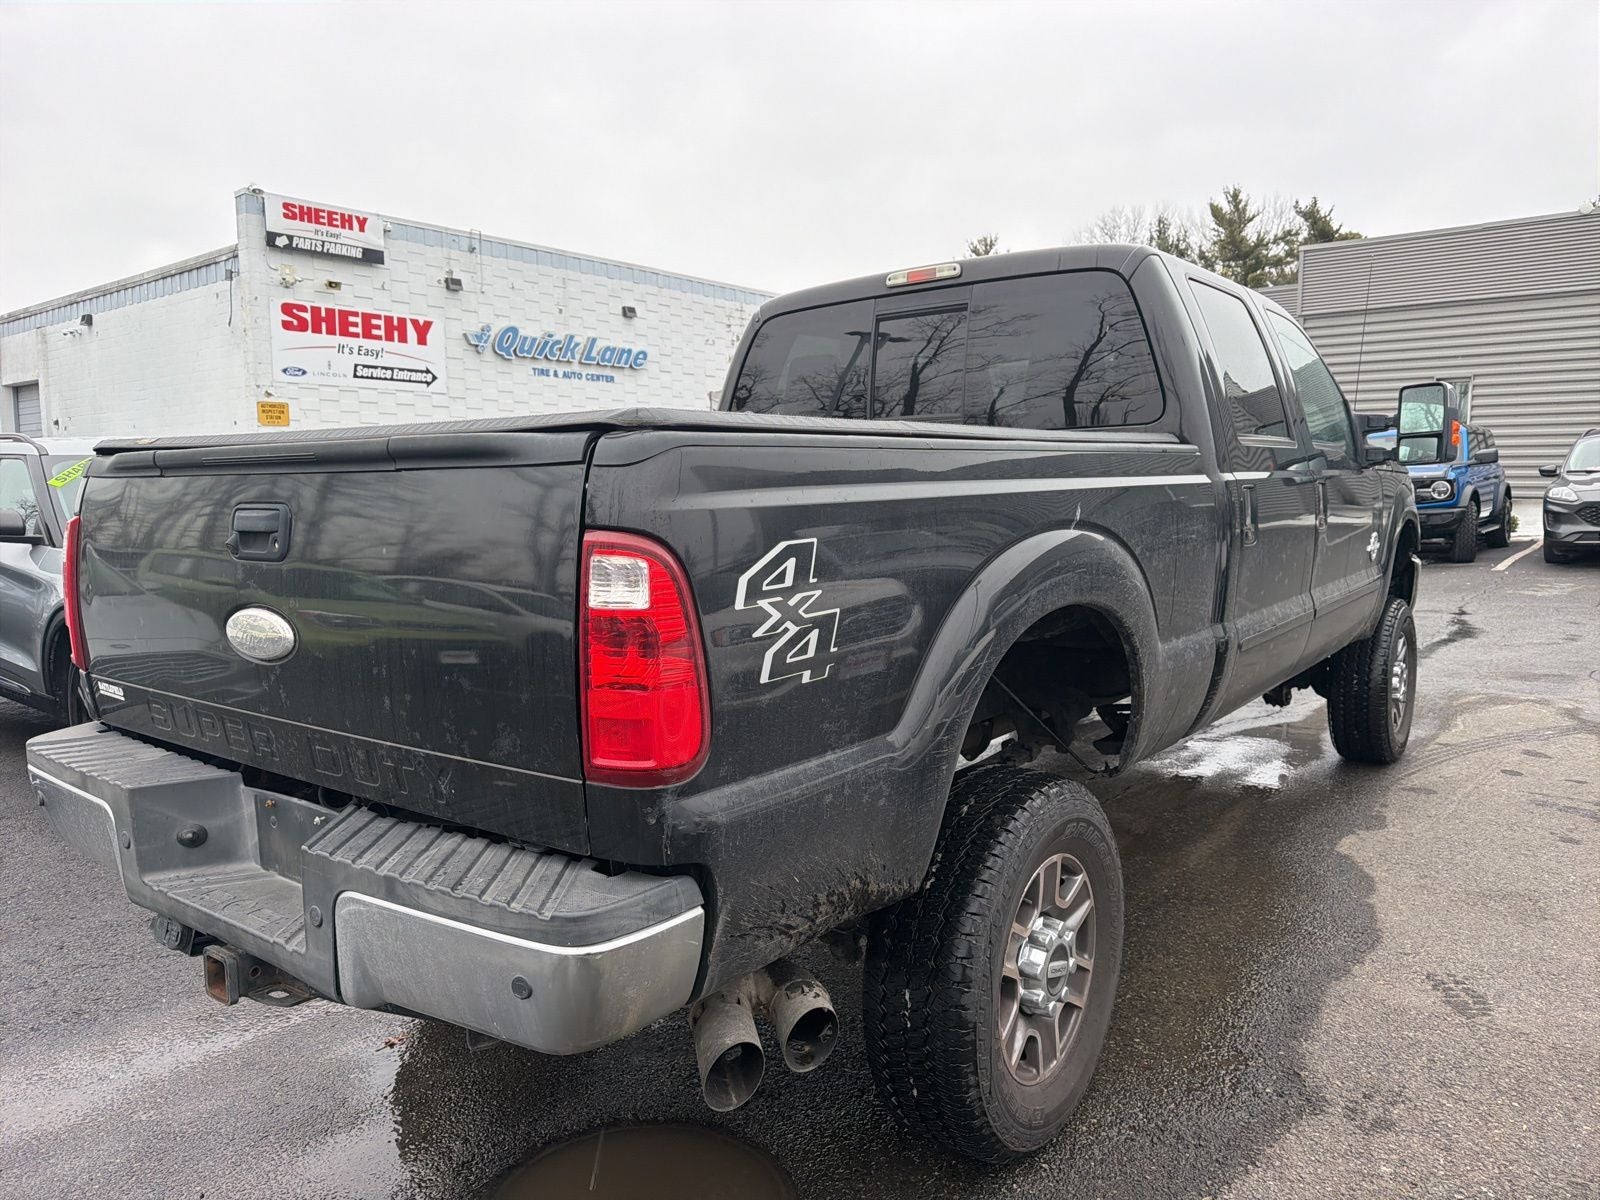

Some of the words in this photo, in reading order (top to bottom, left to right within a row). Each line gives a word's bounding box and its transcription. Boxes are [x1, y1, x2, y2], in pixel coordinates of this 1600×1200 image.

[282, 202, 368, 233] SHEEHY
[314, 229, 324, 237] It's
[326, 230, 342, 240] Easy!
[292, 236, 323, 252] PARTS
[323, 241, 363, 259] PARKING
[280, 302, 434, 346] SHEEHY
[337, 343, 354, 356] It's
[357, 345, 384, 360] Easy!
[493, 326, 582, 361] Quick
[579, 336, 648, 369] Lane
[355, 365, 393, 379] Service
[392, 368, 433, 382] Entrance
[532, 367, 550, 377] TIRE
[553, 369, 559, 378] &
[562, 371, 583, 381] AUTO
[585, 372, 615, 383] CENTER
[148, 699, 280, 762] SUPER
[308, 735, 454, 805] DUTY
